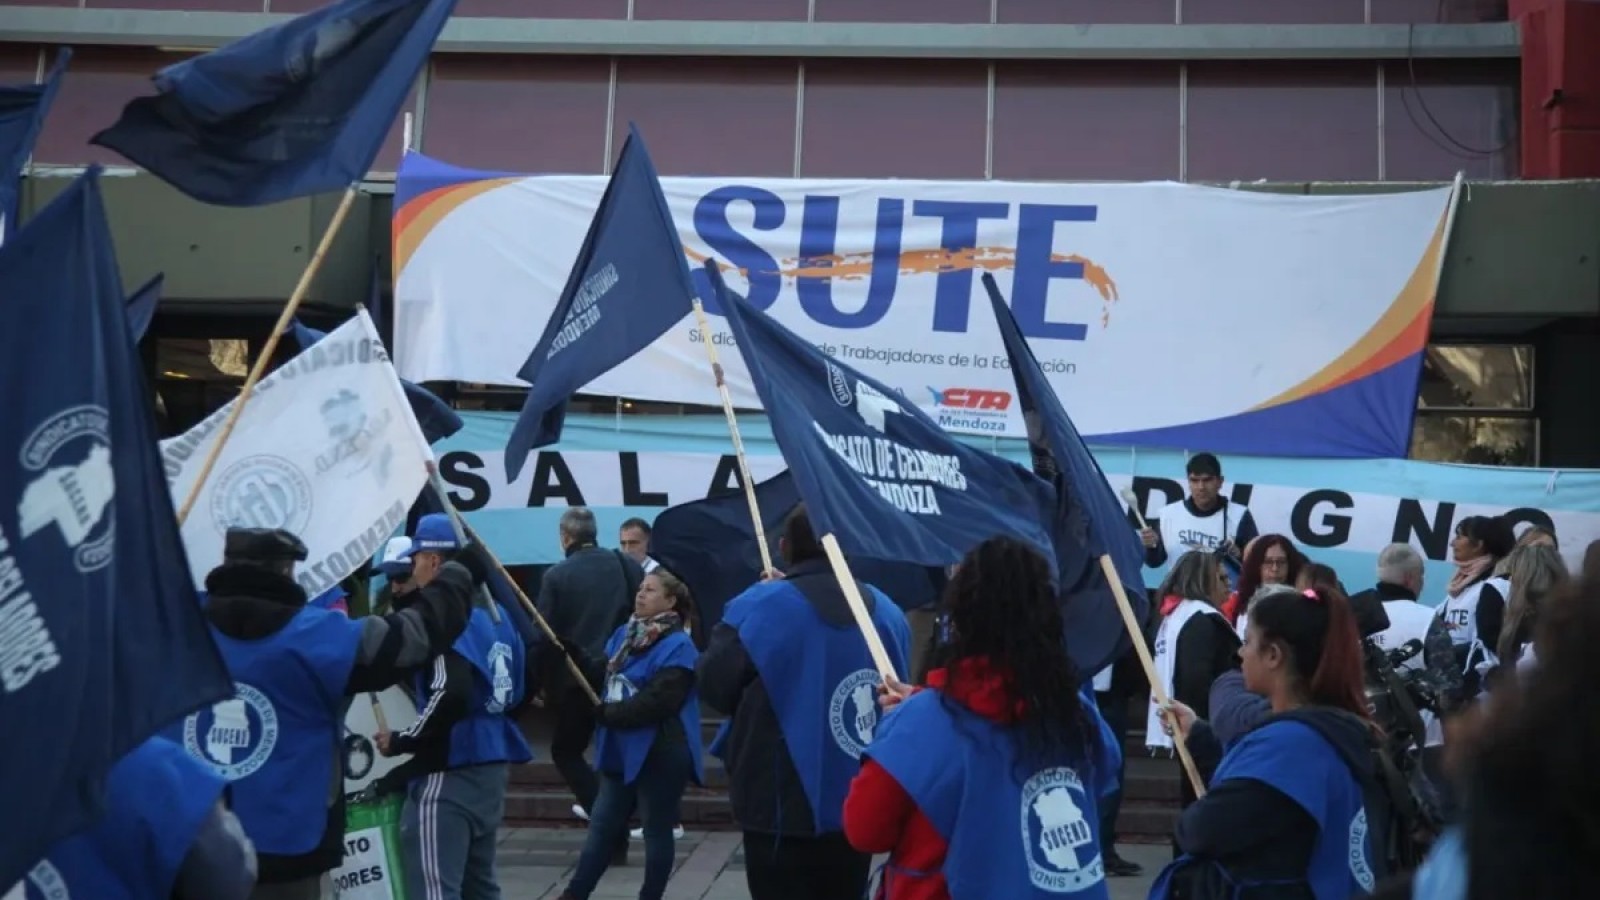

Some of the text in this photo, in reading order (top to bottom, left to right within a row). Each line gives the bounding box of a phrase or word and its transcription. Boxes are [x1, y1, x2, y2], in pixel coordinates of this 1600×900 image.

[693, 185, 1098, 341] SUTE
[688, 328, 738, 346] Sidic
[841, 343, 945, 366] Trabajadorxs
[948, 353, 970, 367] de
[974, 354, 989, 369] la
[991, 355, 1077, 374] Edción
[940, 387, 1012, 411] CTA
[939, 415, 1006, 432] Mendoza
[874, 437, 896, 479] DE
[1178, 529, 1220, 549] SUTE
